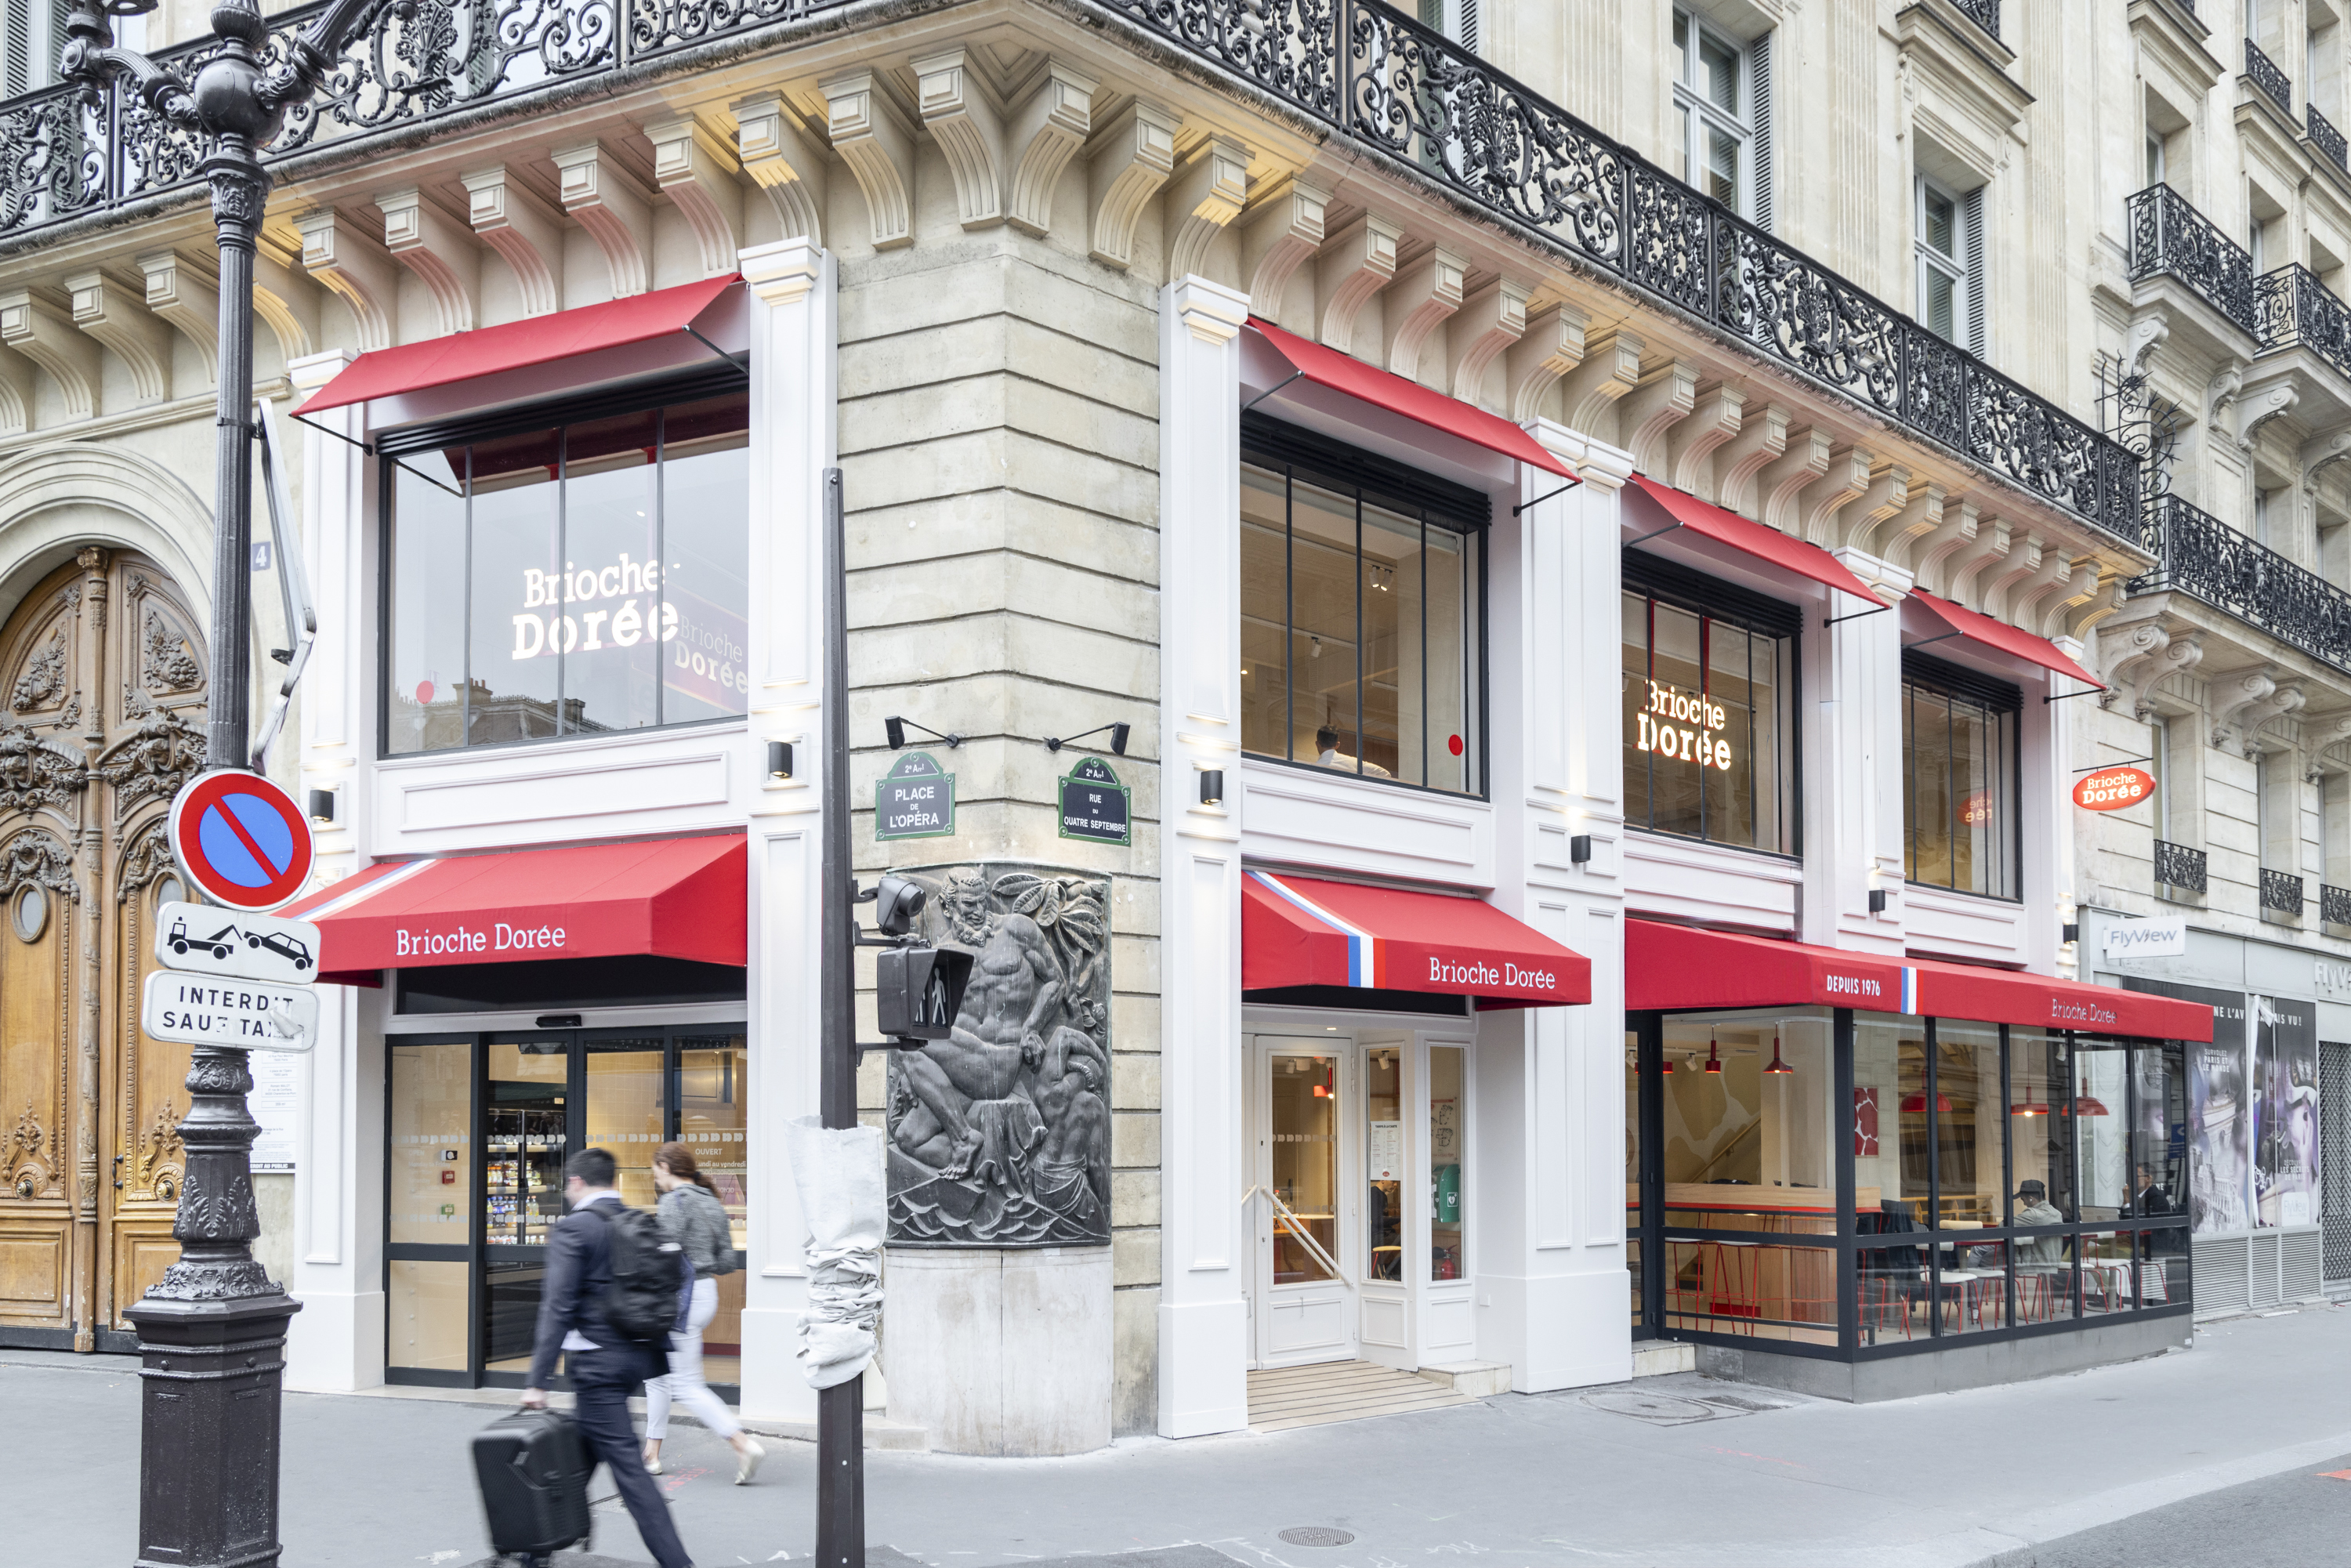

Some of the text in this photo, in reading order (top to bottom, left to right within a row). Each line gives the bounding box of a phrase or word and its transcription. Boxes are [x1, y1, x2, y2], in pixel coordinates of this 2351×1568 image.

[255, 545, 266, 567] 4
[523, 552, 665, 608] Brioche
[512, 599, 679, 660] Dorée
[679, 614, 743, 663] Brioche
[674, 640, 748, 694] Dorée
[1645, 679, 1726, 730] Brioche
[1637, 712, 1731, 770] Dorée
[2087, 773, 2137, 790] Brioche
[895, 786, 935, 802] PLACE
[1089, 793, 1102, 804] RUE
[2082, 784, 2142, 804] Dorée
[889, 810, 940, 828] L'OPÉRA
[1063, 816, 1126, 833] QUATRE SEPTEMBRE
[395, 922, 566, 955] Brioche Dorée
[2110, 929, 2177, 947] FlyView
[1429, 956, 1556, 990] Brioche Dorée
[1827, 974, 1881, 997] DEPUIS 1976
[2052, 998, 2117, 1024] Brioche Dorée
[2204, 1048, 2227, 1057] SURVOLEZ
[2211, 1064, 2230, 1073] MONDE
